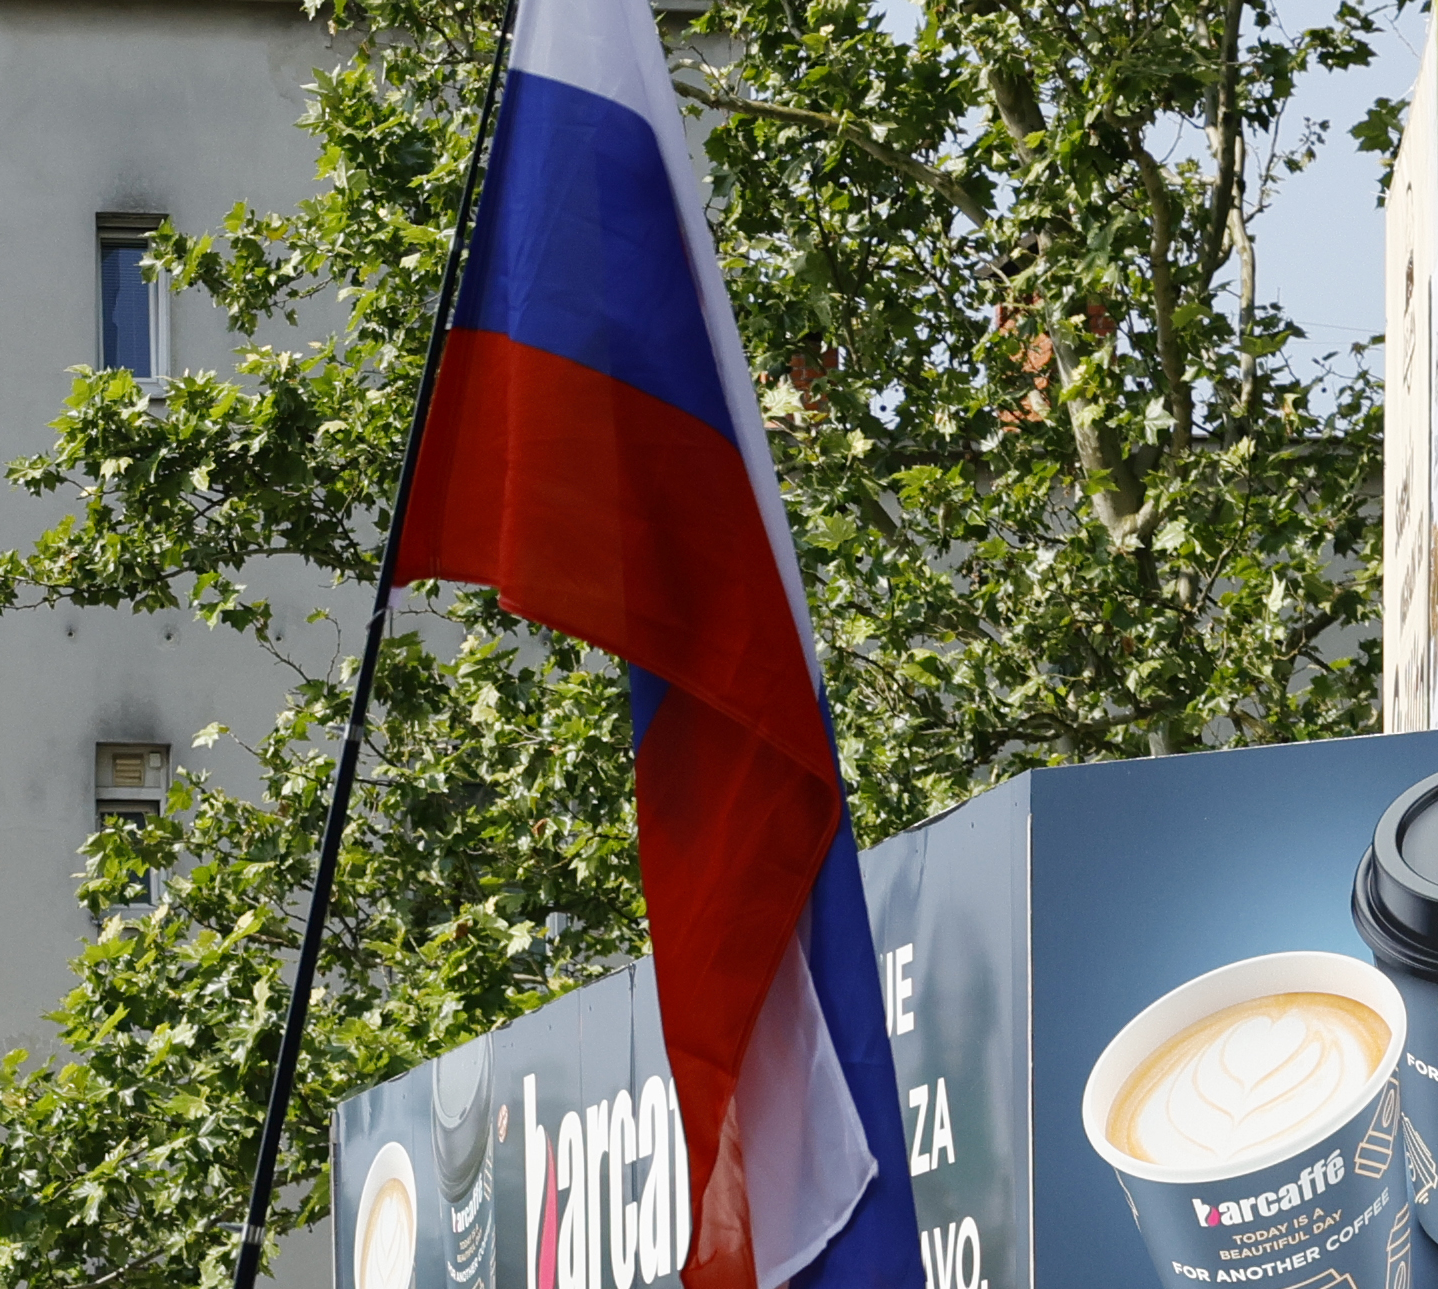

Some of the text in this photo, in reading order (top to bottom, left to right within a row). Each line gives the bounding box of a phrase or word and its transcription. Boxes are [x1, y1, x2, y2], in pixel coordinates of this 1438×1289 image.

[909, 1077, 956, 1178] ZA
[1193, 1150, 1345, 1229] barcaffé
[1233, 1208, 1325, 1246] TODAY IS A
[1172, 1187, 1390, 1285] FOR ANOTHER COFFEE
[1219, 1209, 1343, 1261] BEAUTIFUL DAY
